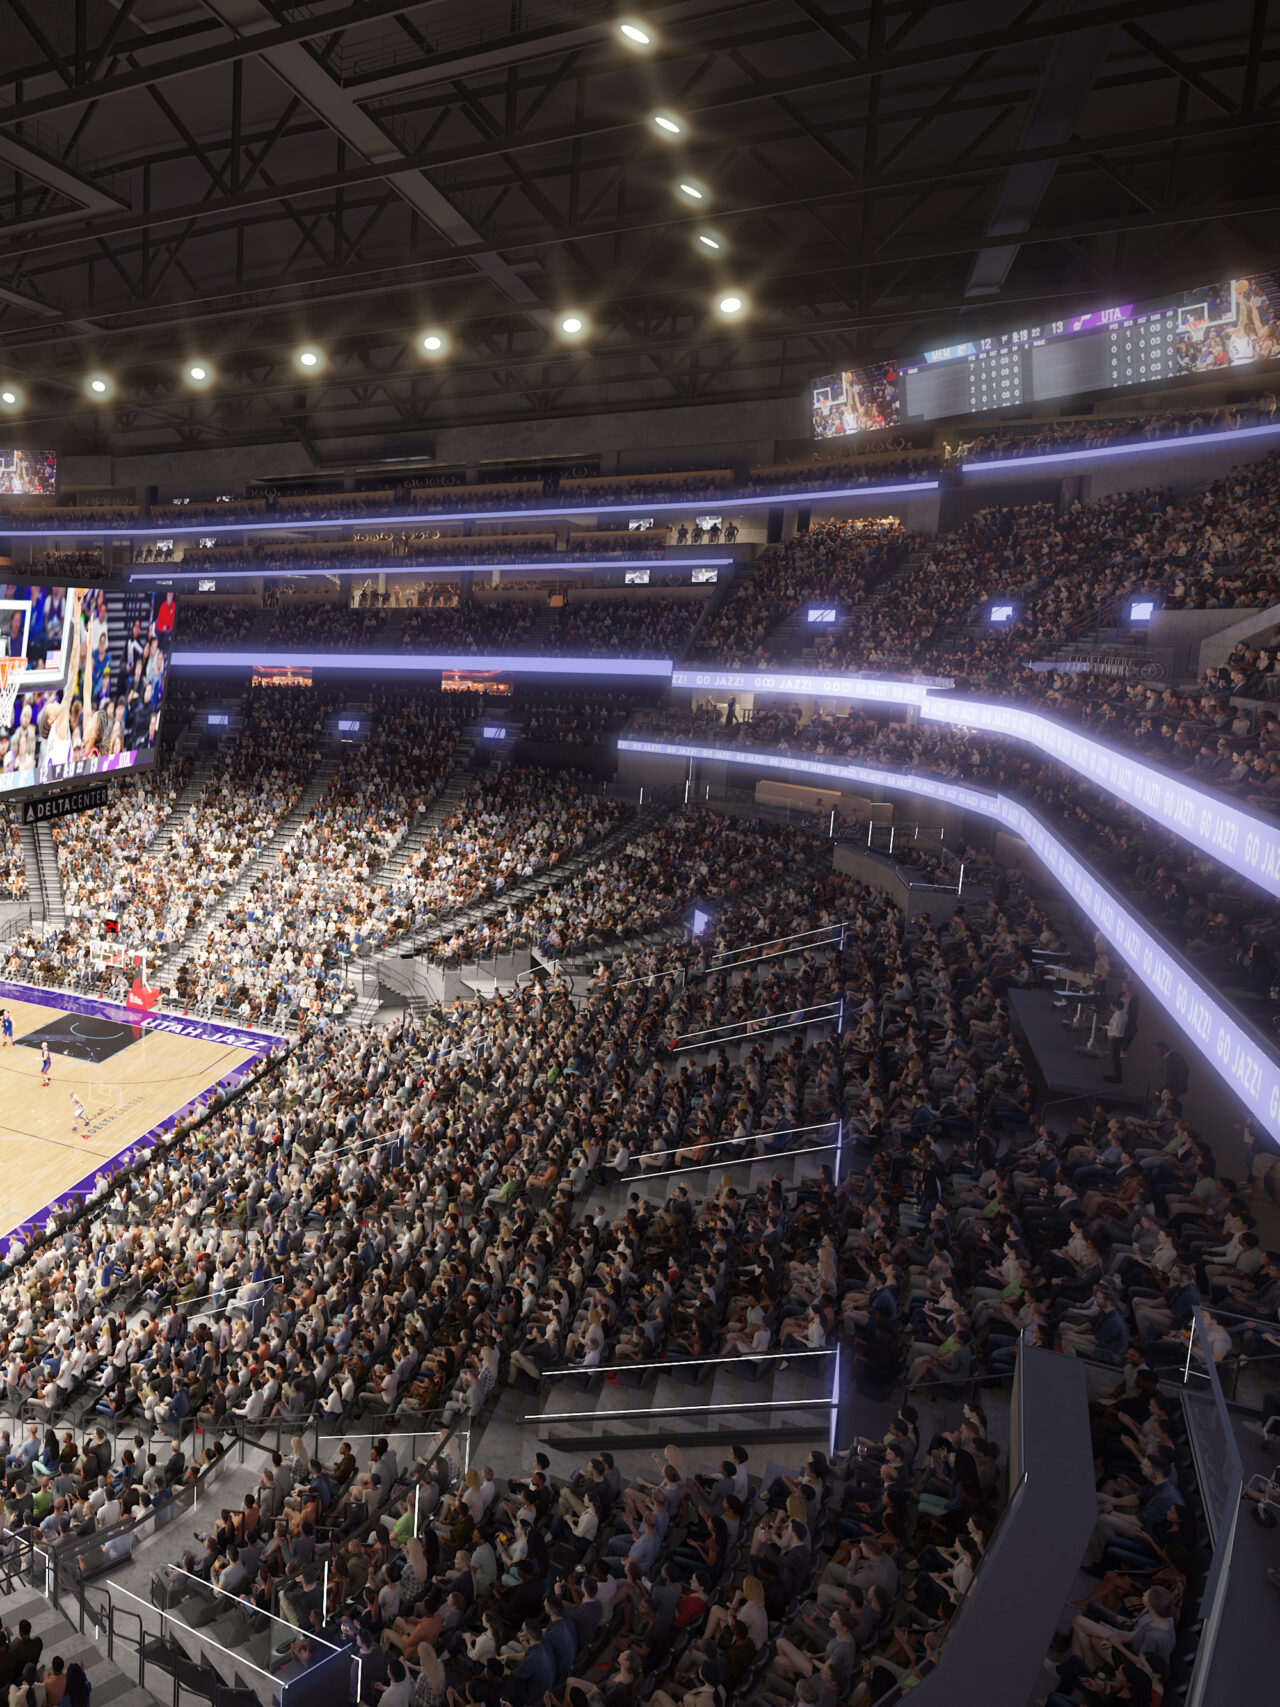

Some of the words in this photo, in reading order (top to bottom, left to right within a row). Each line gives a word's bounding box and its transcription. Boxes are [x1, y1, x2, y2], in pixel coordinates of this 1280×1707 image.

[931, 348, 951, 361] MEM
[980, 338, 991, 351] 12
[1031, 327, 1040, 337] 22
[1052, 320, 1063, 334] 13
[1101, 307, 1121, 322] UTA
[696, 675, 711, 685] GO
[714, 675, 744, 687] JAZZ!
[779, 679, 813, 690] JAZZ!
[40, 767, 48, 782] 12
[90, 757, 98, 773] 13
[1164, 788, 1174, 817] GO
[1174, 795, 1196, 830] JAZZ!
[1200, 808, 1212, 839] GO
[1212, 815, 1239, 854] JAZZ!
[1244, 831, 1259, 867] GO
[106, 920, 118, 933] 24
[140, 1017, 204, 1037] UTAH
[202, 1032, 270, 1050] JAZZ
[1143, 946, 1153, 975] GO
[1152, 957, 1172, 998] JAZZ!
[1176, 982, 1188, 1015] GO
[1188, 992, 1212, 1042] JAZZ!
[1217, 1027, 1231, 1064] GO
[1232, 1046, 1263, 1100] JAZZ!
[1270, 1084, 1280, 1128] G
